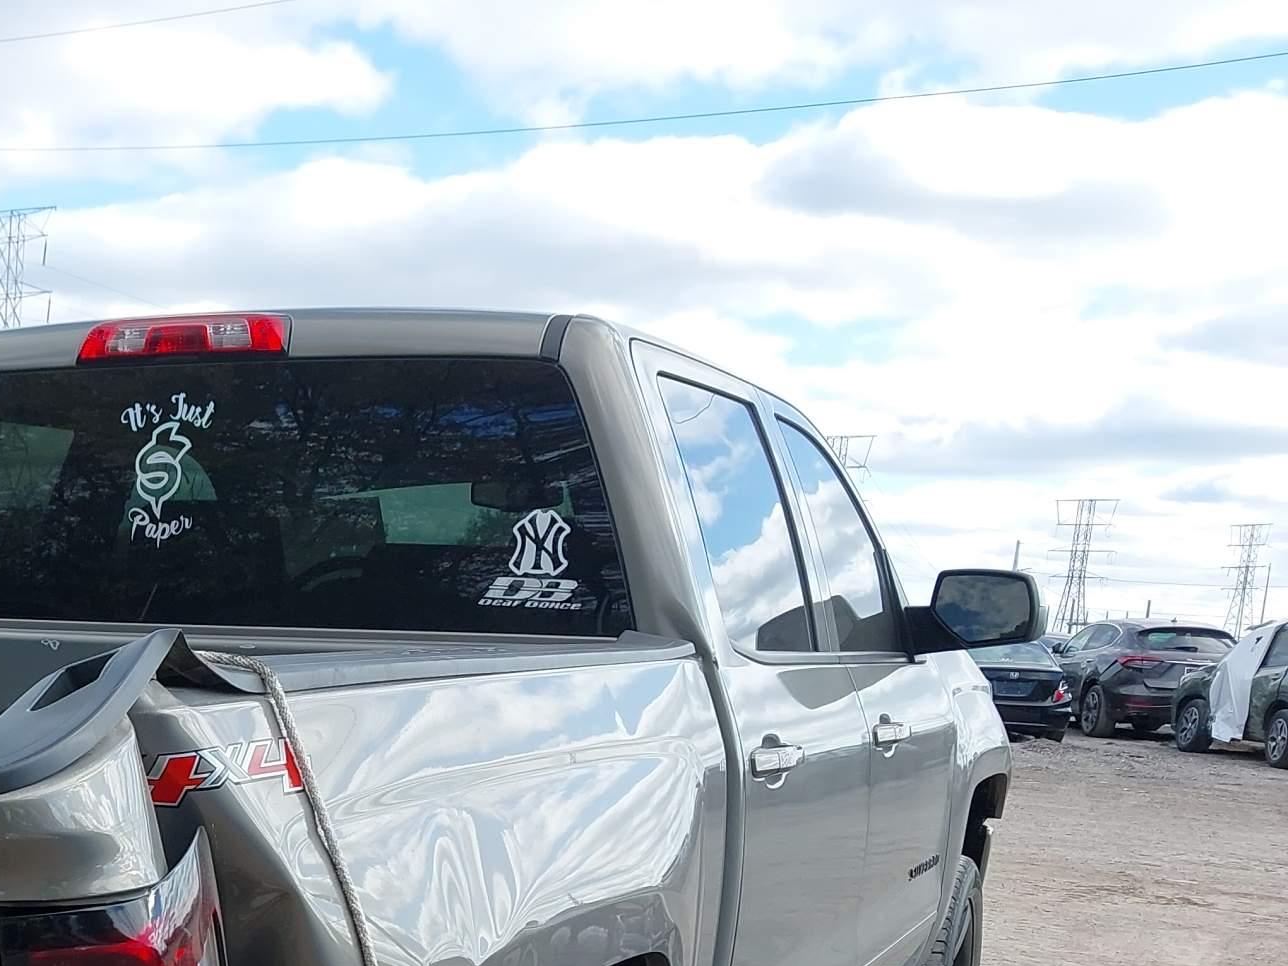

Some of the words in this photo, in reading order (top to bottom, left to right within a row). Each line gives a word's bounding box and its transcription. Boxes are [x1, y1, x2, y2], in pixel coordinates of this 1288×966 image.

[120, 402, 162, 432] It's
[169, 392, 215, 429] Just
[128, 507, 193, 549] Paper
